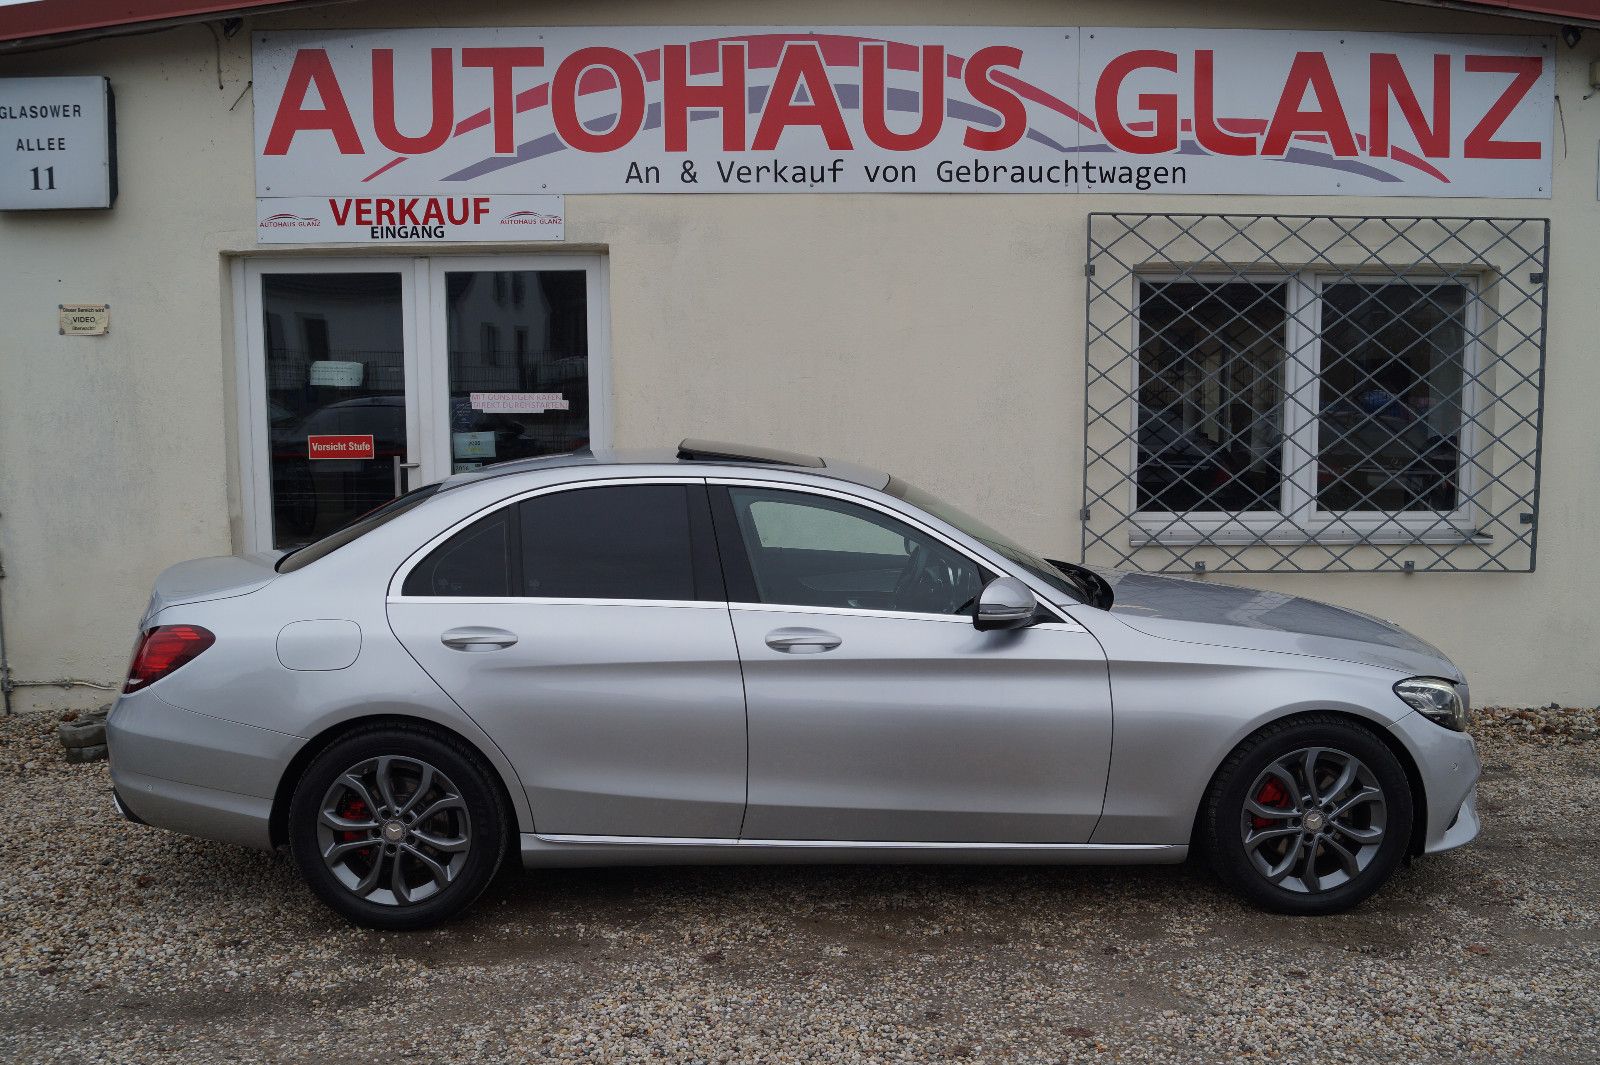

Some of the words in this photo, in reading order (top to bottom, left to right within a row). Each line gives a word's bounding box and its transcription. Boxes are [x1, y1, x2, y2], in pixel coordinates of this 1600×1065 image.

[262, 43, 1027, 156] AUTOHAUS
[1095, 48, 1542, 159] GLANZ
[0, 105, 81, 119] GLASOWER
[16, 138, 66, 151] ALLEE
[30, 166, 57, 190] 11
[625, 161, 661, 183] An
[680, 161, 699, 183] &
[716, 160, 844, 183] Verkauf
[864, 166, 916, 184] von
[936, 160, 1188, 190] Gebrauchtwagen
[329, 198, 490, 226] VERKAUF
[371, 225, 445, 239] EINGANG
[312, 442, 347, 451] Vorsicht
[348, 442, 371, 451] Stufe
